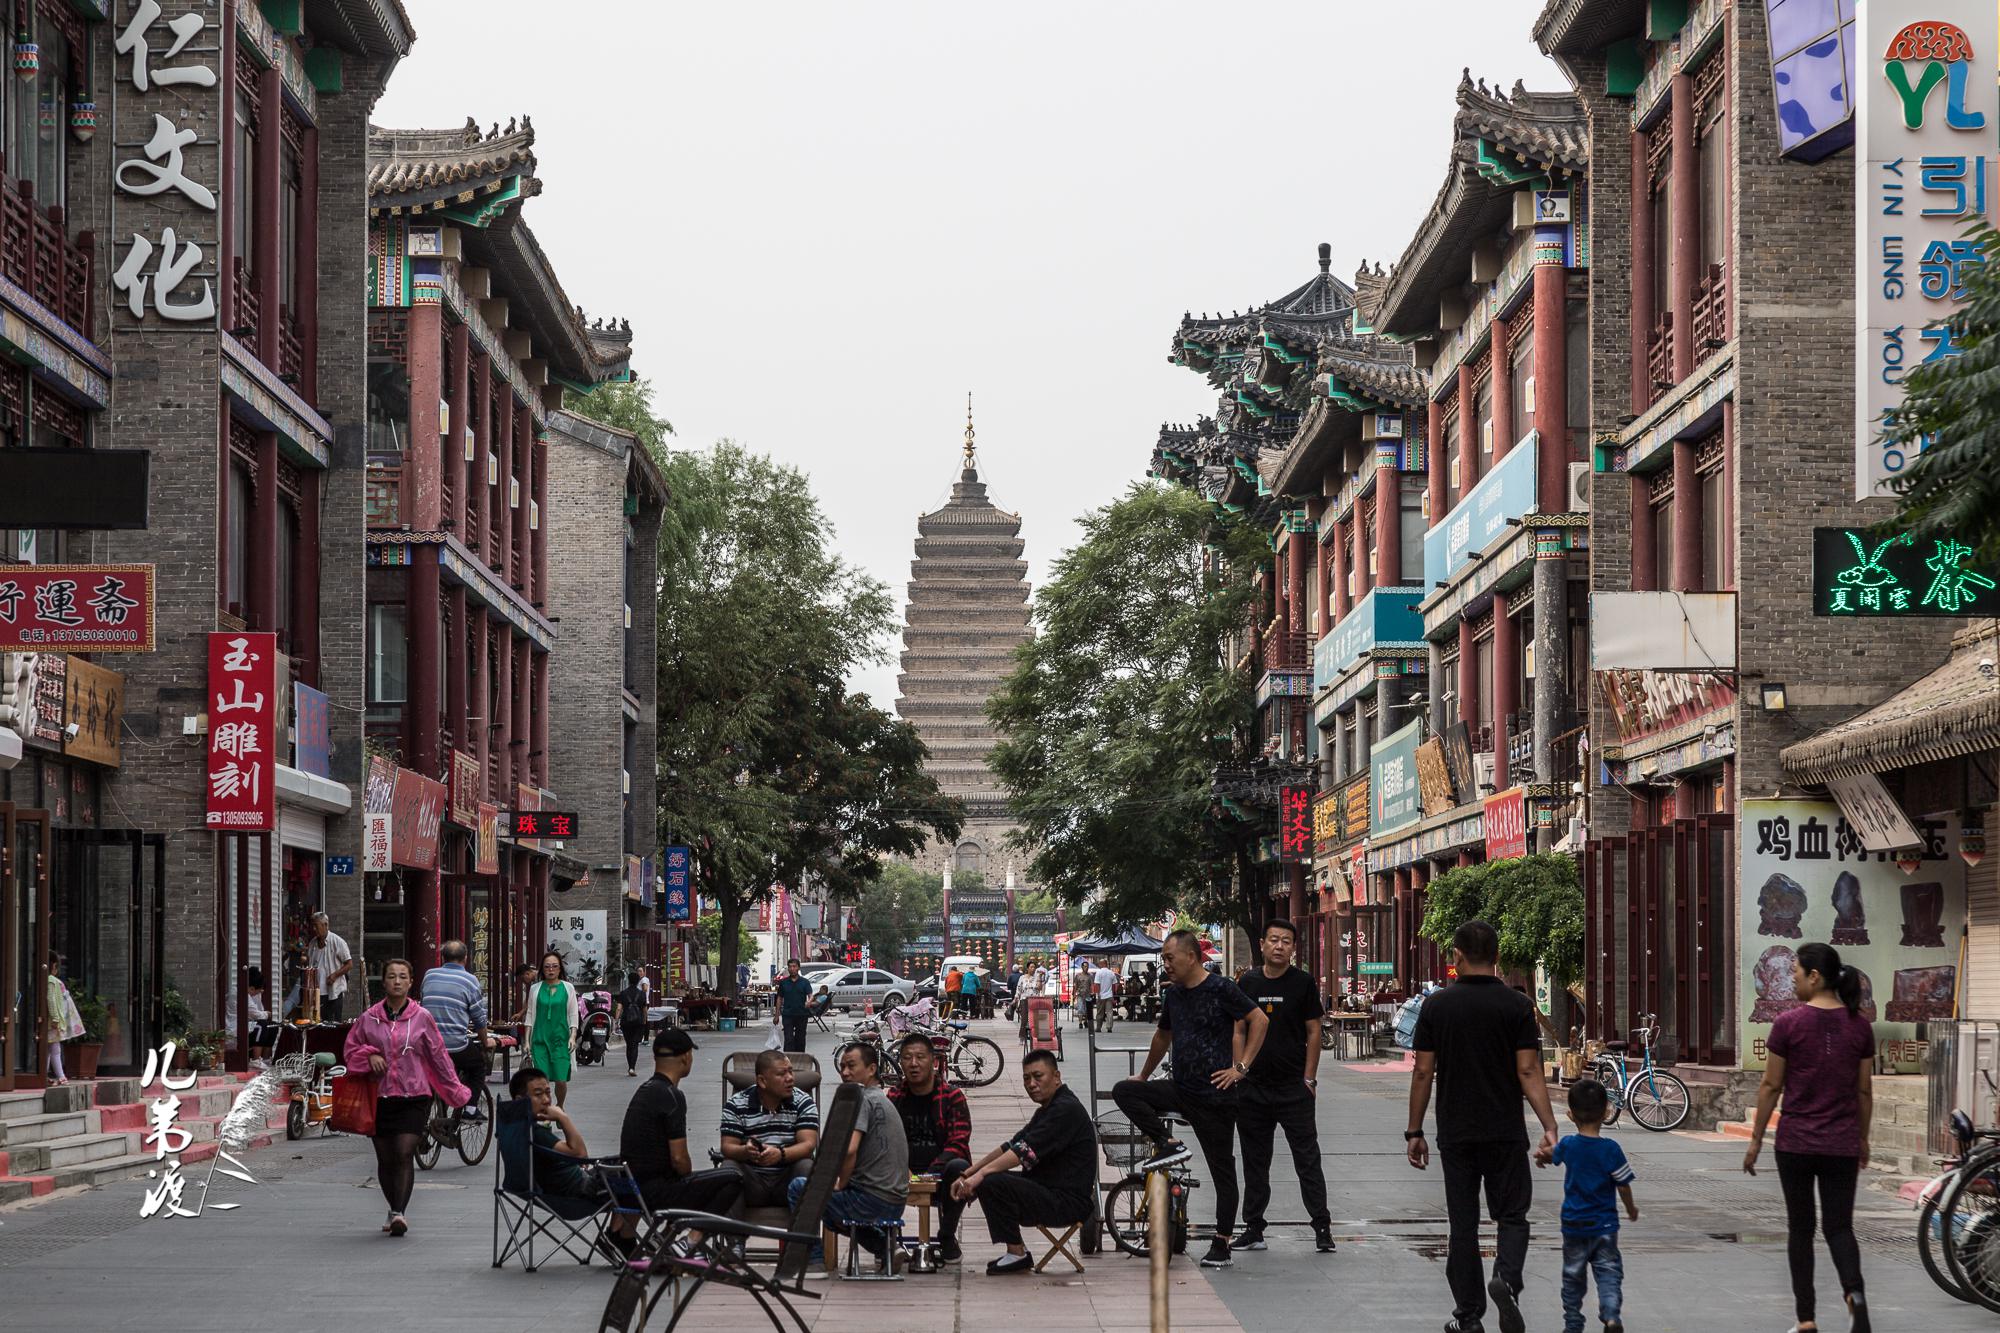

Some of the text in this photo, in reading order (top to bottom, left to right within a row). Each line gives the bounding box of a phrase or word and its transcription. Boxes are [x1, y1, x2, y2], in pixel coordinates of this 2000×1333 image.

[1884, 60, 1986, 130] YL
[113, 0, 218, 321] 仁文化
[1882, 157, 1904, 216] YIN
[1882, 236, 1904, 300] LING
[1919, 155, 1987, 458] 引领
[1882, 324, 1904, 385] YOU
[210, 637, 265, 806] 玉山雕刻
[370, 818, 388, 869] 匯福源
[517, 814, 572, 836] 珠宝
[1756, 815, 1949, 862] 鸡血树玉
[333, 864, 348, 873] 8-7
[668, 853, 686, 905] 好石缘
[550, 916, 584, 931] 收购
